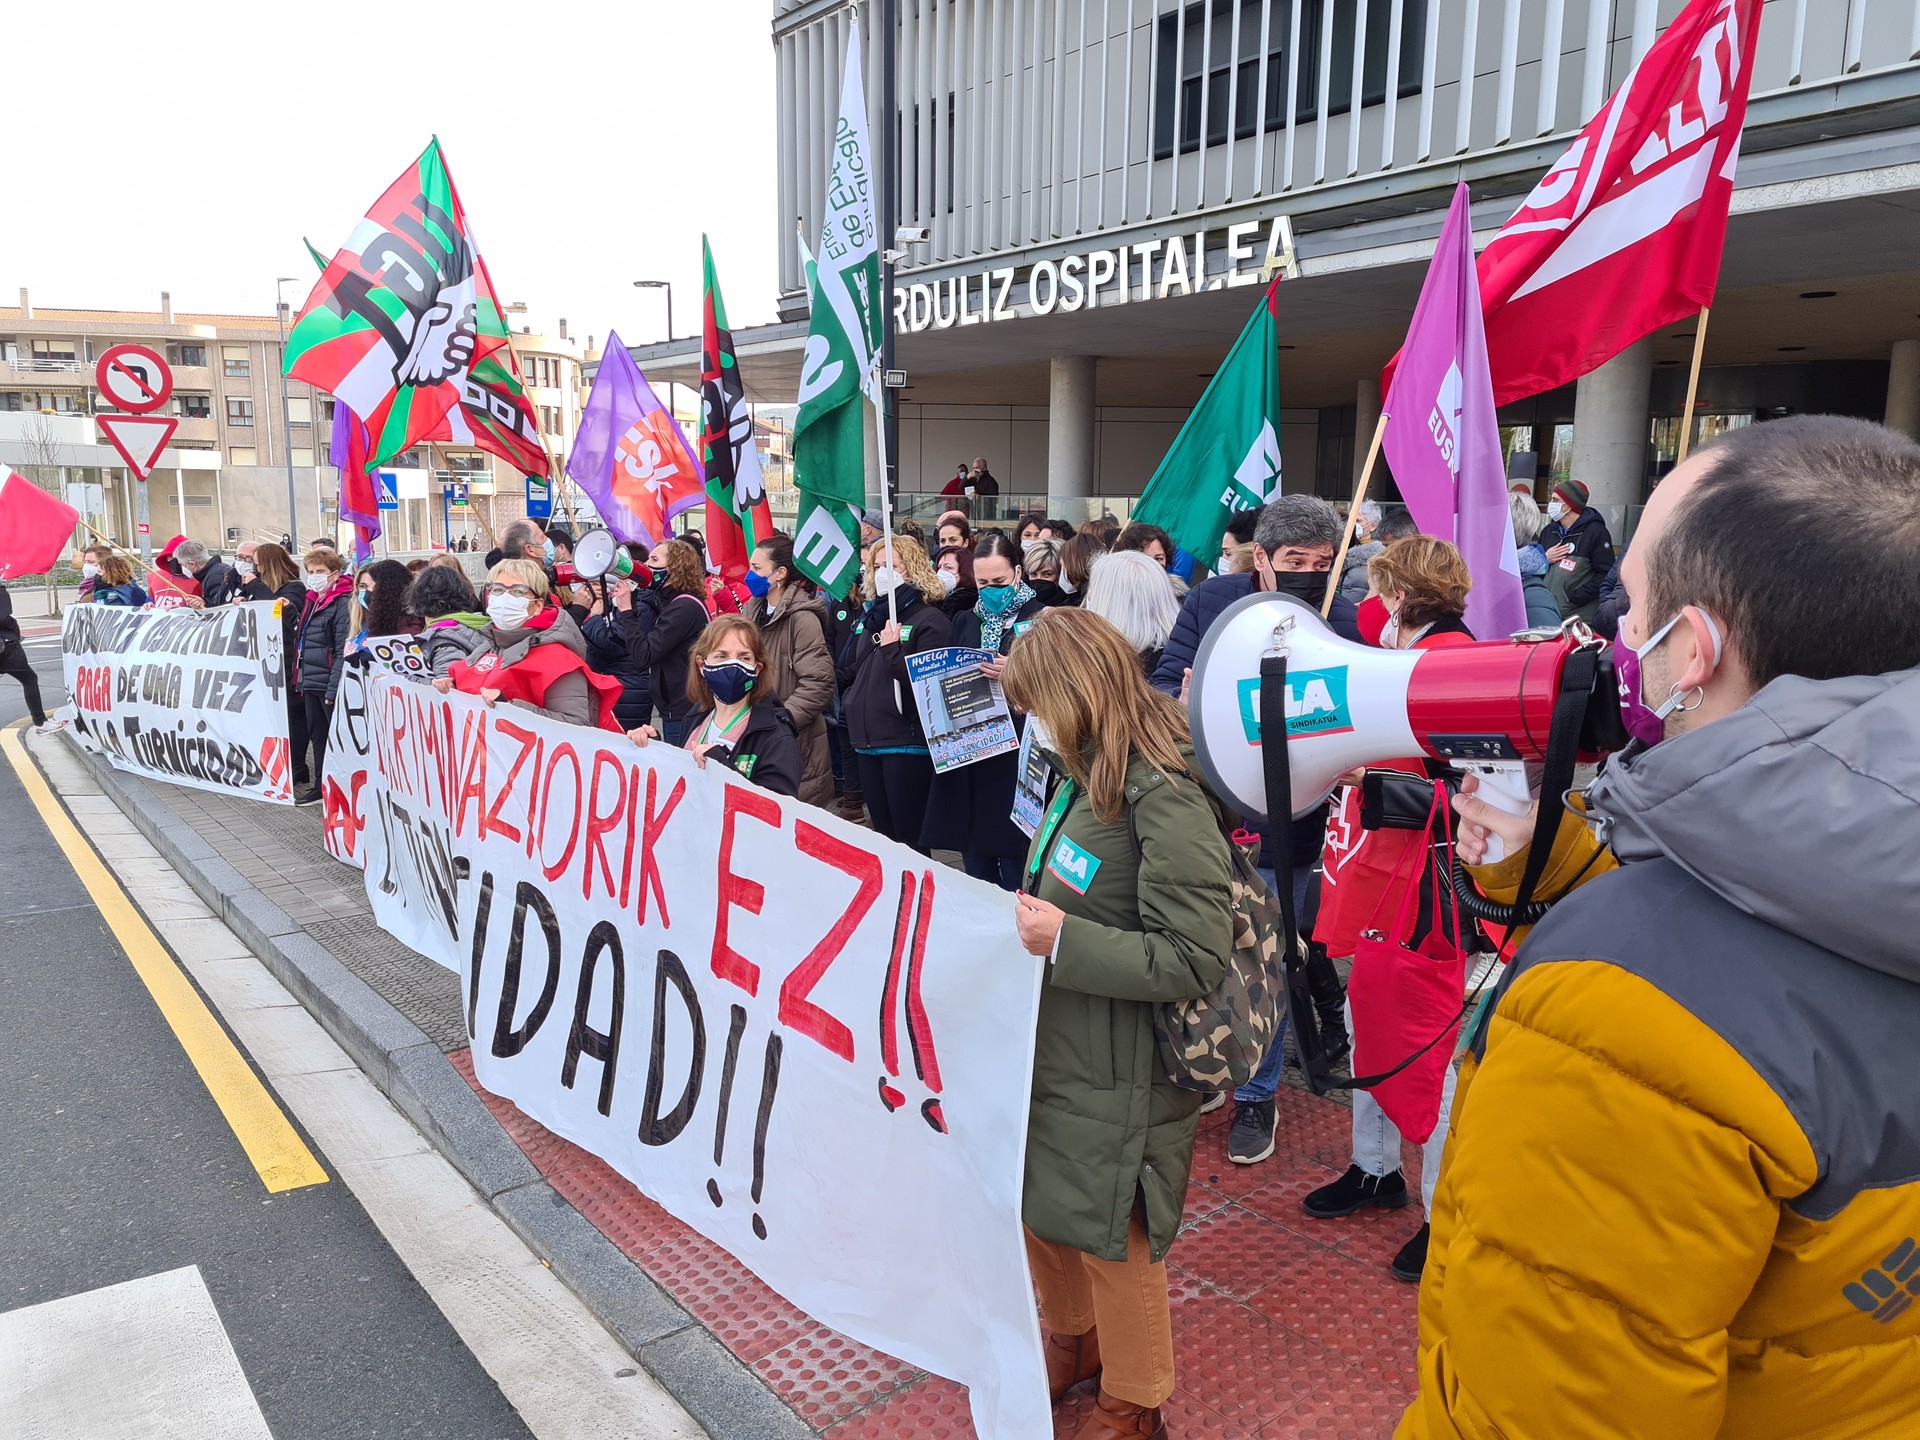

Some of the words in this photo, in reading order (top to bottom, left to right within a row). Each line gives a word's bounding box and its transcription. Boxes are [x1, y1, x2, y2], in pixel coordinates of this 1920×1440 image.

[881, 266, 1017, 334] RDULIZ
[1029, 215, 1300, 315] OSPITALEA
[912, 650, 949, 668] HUELGA
[76, 665, 112, 712] PAGA
[117, 664, 142, 703] DE
[142, 663, 183, 709] UNA
[192, 668, 257, 714] VEZ
[1290, 715, 1338, 729] SINDIKATUA
[1055, 842, 1089, 880] ELA
